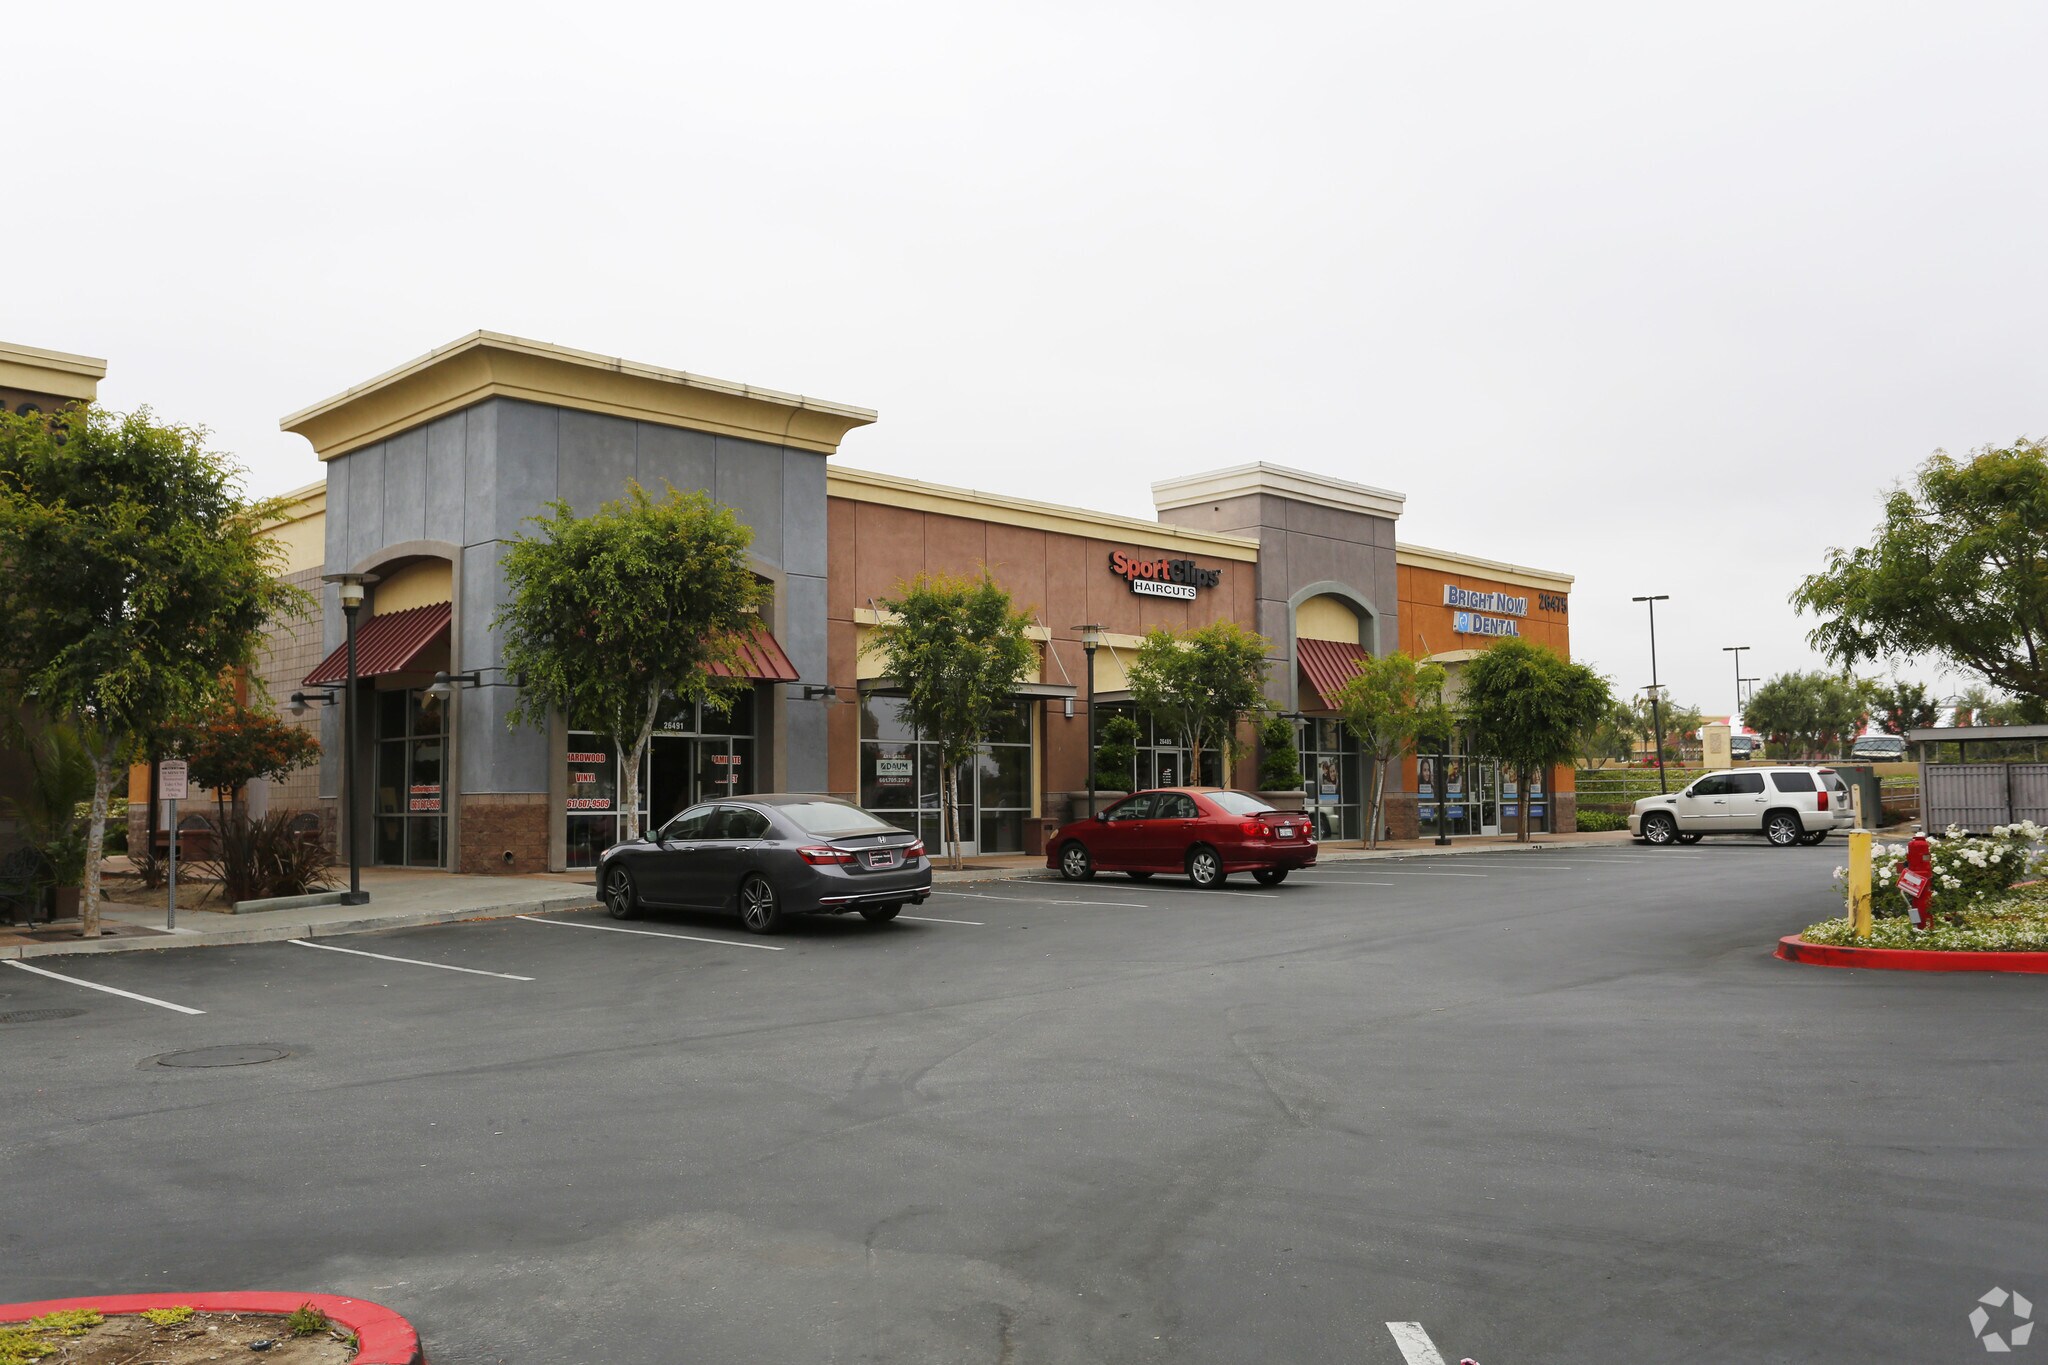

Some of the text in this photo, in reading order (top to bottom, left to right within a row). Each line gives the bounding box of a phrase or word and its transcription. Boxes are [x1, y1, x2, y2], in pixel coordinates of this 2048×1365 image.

[1134, 581, 1196, 598] HAIRCUTS
[1448, 585, 1528, 615] BRIGHT NOW!
[1538, 592, 1568, 614] 26475
[1472, 614, 1519, 637] DENTAL
[663, 721, 684, 730] 26491
[886, 762, 908, 770] DAUM
[575, 773, 596, 783] VINYL
